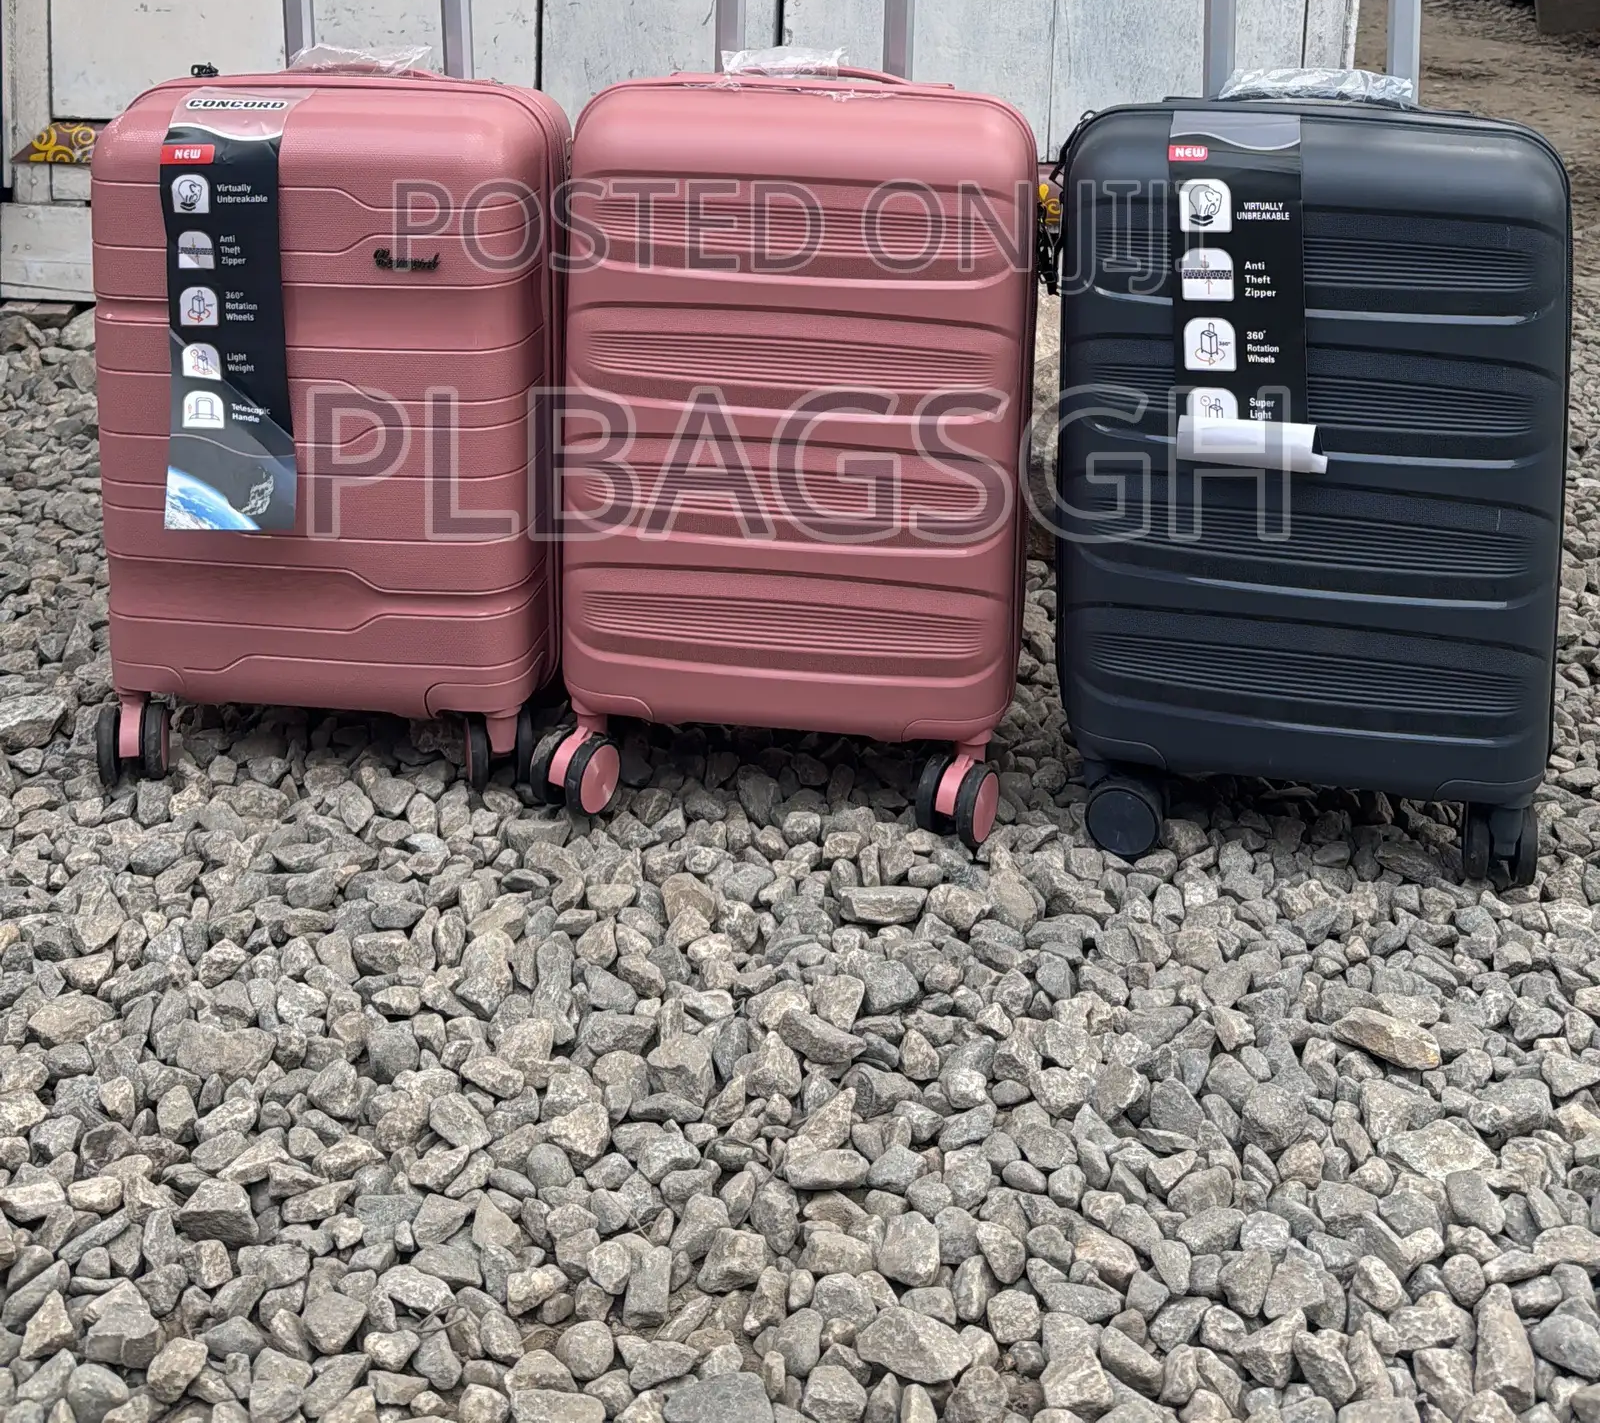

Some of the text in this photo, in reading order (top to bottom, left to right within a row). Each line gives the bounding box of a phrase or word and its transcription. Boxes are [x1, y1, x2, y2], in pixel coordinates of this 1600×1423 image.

[189, 99, 285, 109] CONCORD
[174, 149, 201, 159] NEW
[1175, 148, 1205, 157] NEW
[217, 184, 251, 193] Virtually
[1244, 202, 1284, 211] VIRTUALLY
[1236, 211, 1290, 221] UNBREAKABLE
[220, 235, 236, 243] Anti
[221, 246, 241, 255] Theft
[221, 257, 246, 266] Zipper
[1244, 261, 1265, 270] Anti
[1245, 275, 1271, 284] Theft
[1244, 288, 1277, 298] Zipper
[225, 302, 258, 310] Rotation
[226, 313, 254, 321] Wheels
[1246, 344, 1280, 353] Rotation
[227, 353, 247, 362] Light
[1247, 354, 1275, 363] Wheels
[227, 364, 254, 373] Weight
[1249, 398, 1275, 408] Super
[231, 403, 271, 416] Telescopic
[232, 413, 260, 423] Handle
[1249, 409, 1272, 420] Light
